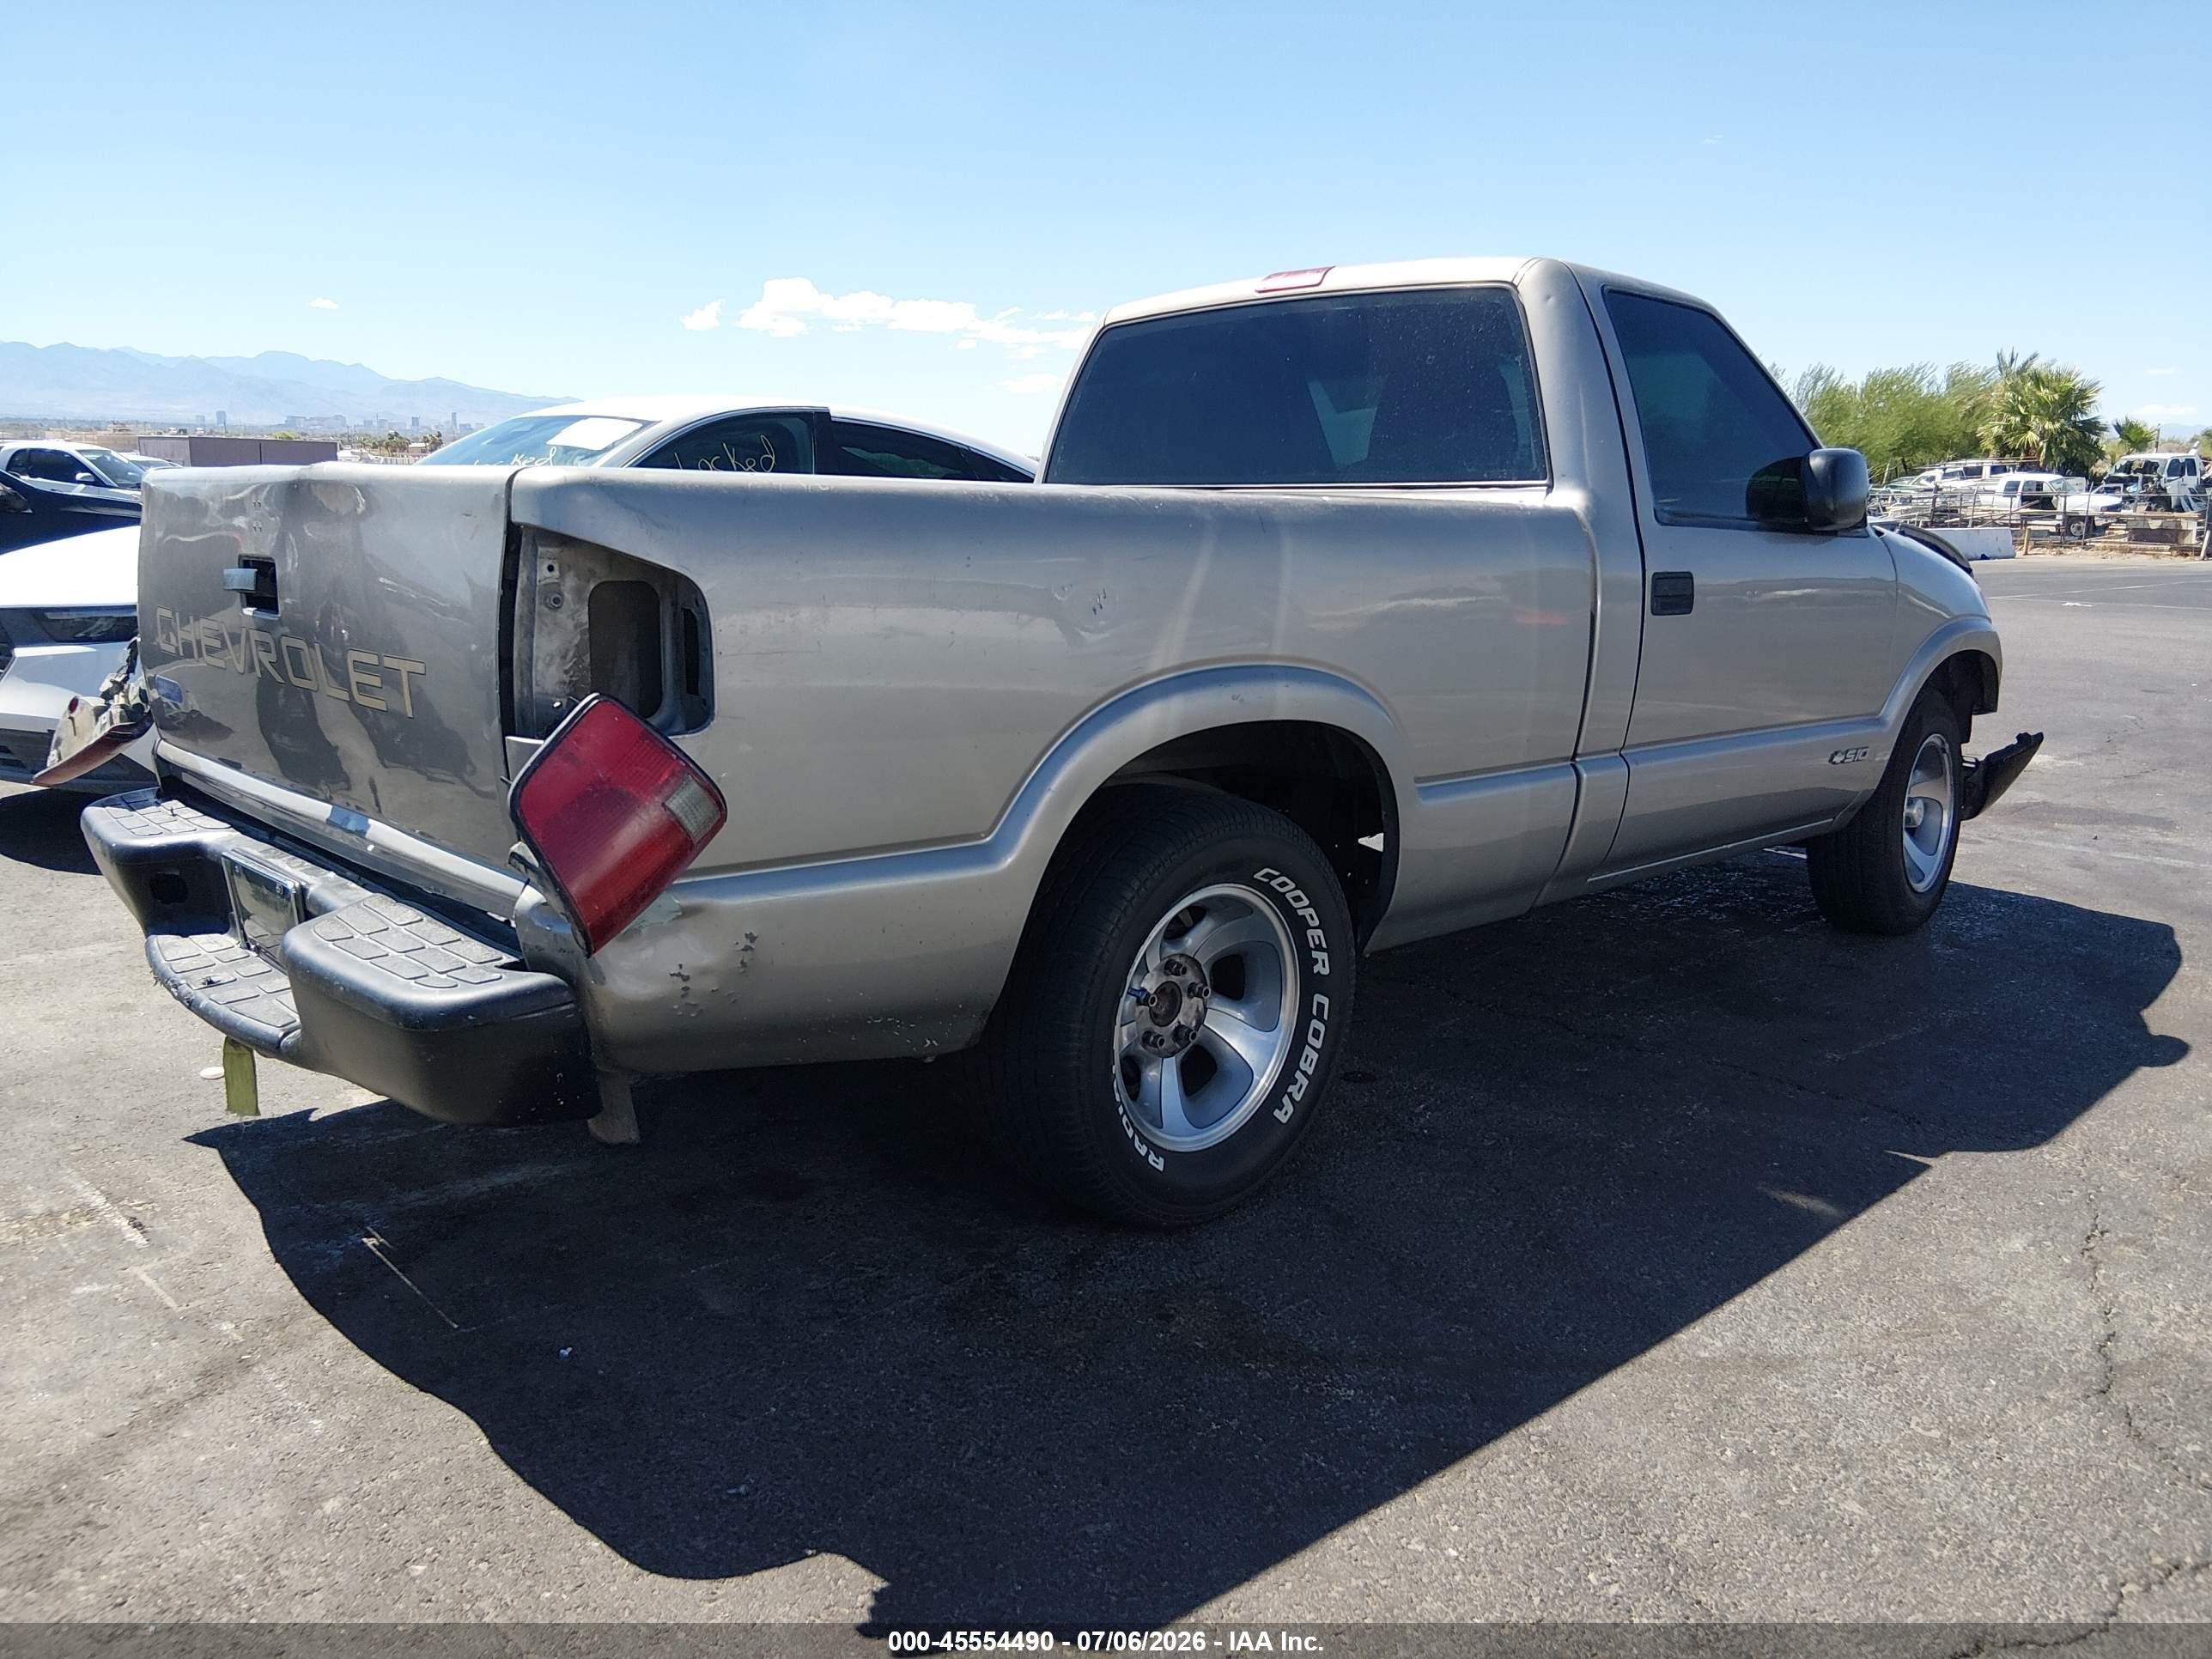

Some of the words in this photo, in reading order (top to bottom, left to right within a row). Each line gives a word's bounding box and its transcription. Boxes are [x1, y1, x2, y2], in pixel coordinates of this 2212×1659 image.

[155, 605, 427, 720] CHEVROLET
[1254, 867, 1330, 976] COOPER
[1273, 992, 1330, 1125] COBRA
